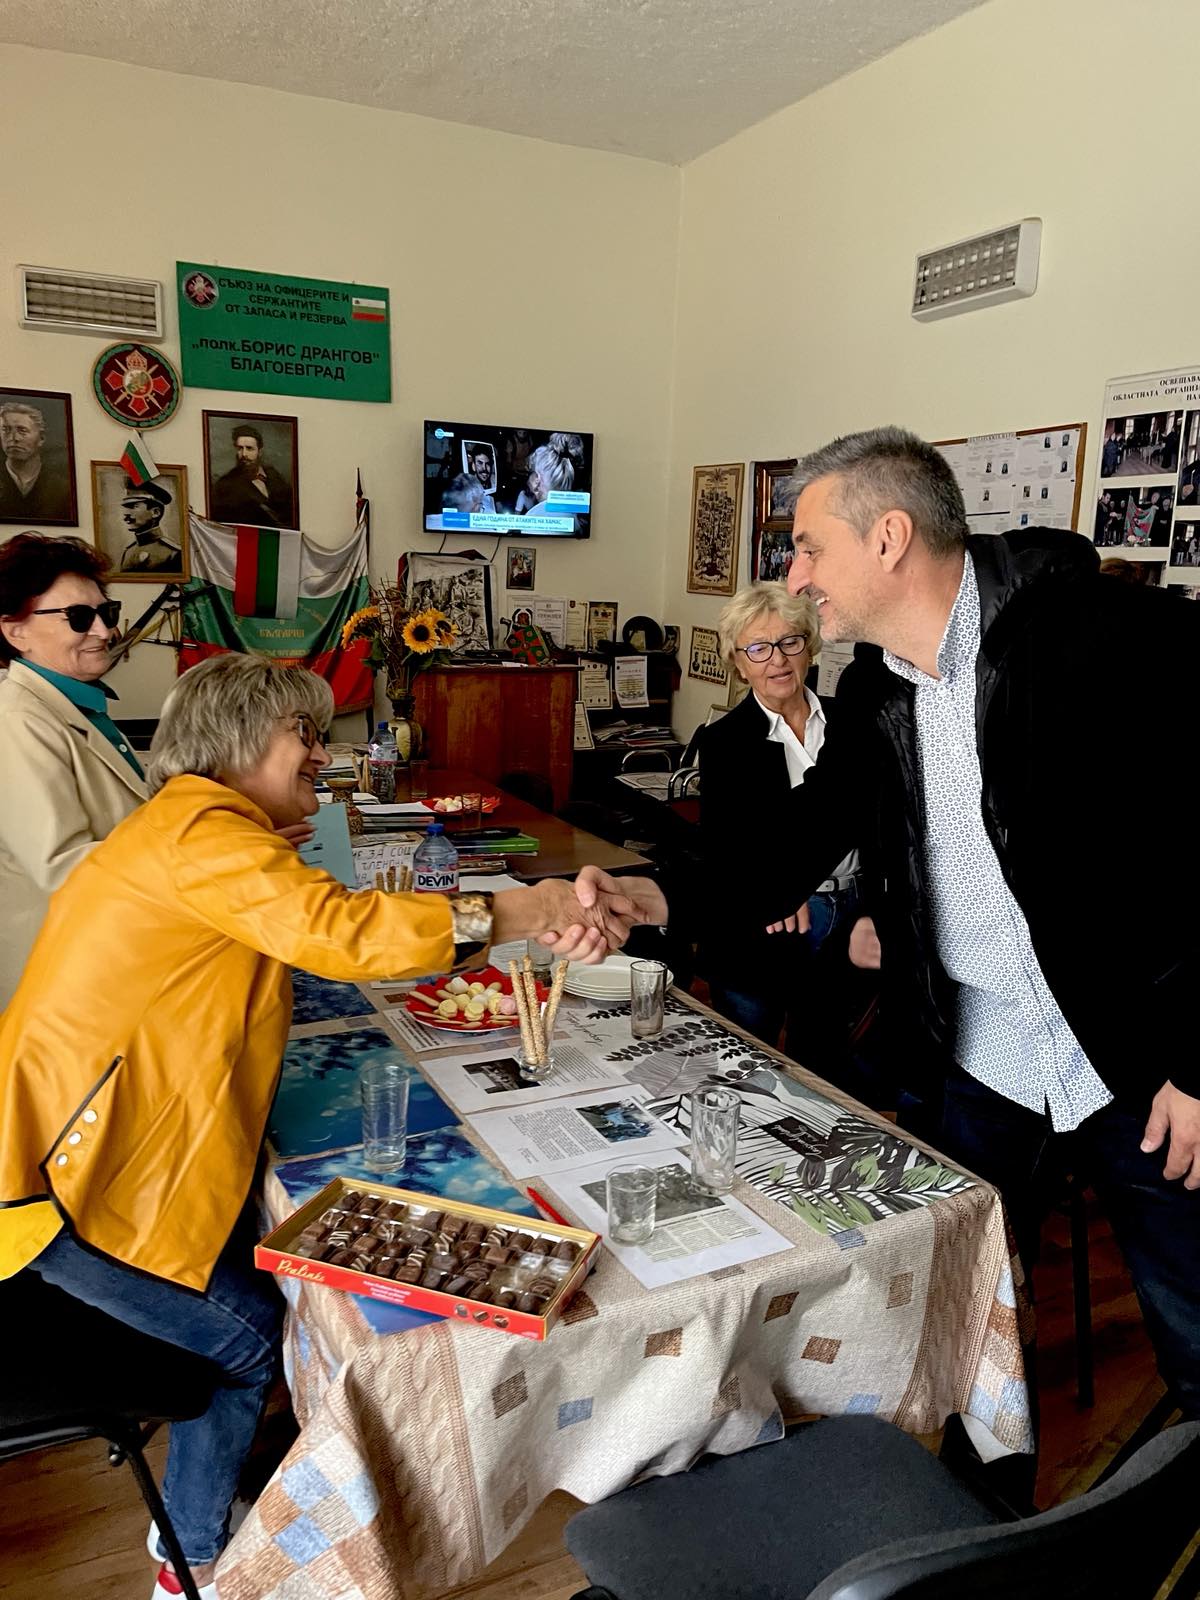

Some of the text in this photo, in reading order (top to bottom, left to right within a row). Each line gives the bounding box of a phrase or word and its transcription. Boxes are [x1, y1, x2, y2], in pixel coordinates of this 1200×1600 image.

[218, 278, 350, 303] СЪЮЗ НА ОФИЦЕРИТЕ И
[248, 294, 321, 311] СЕРЖАНТИТЕ
[225, 304, 348, 326] ОТ ЗАПАСА И РЕЗЕРВА
[230, 356, 345, 382] БЛАГОЕВГРАД
[1112, 389, 1159, 401] ОБЛАСТНАТА
[367, 849, 384, 860] ЗА
[417, 873, 454, 888] DEVIN
